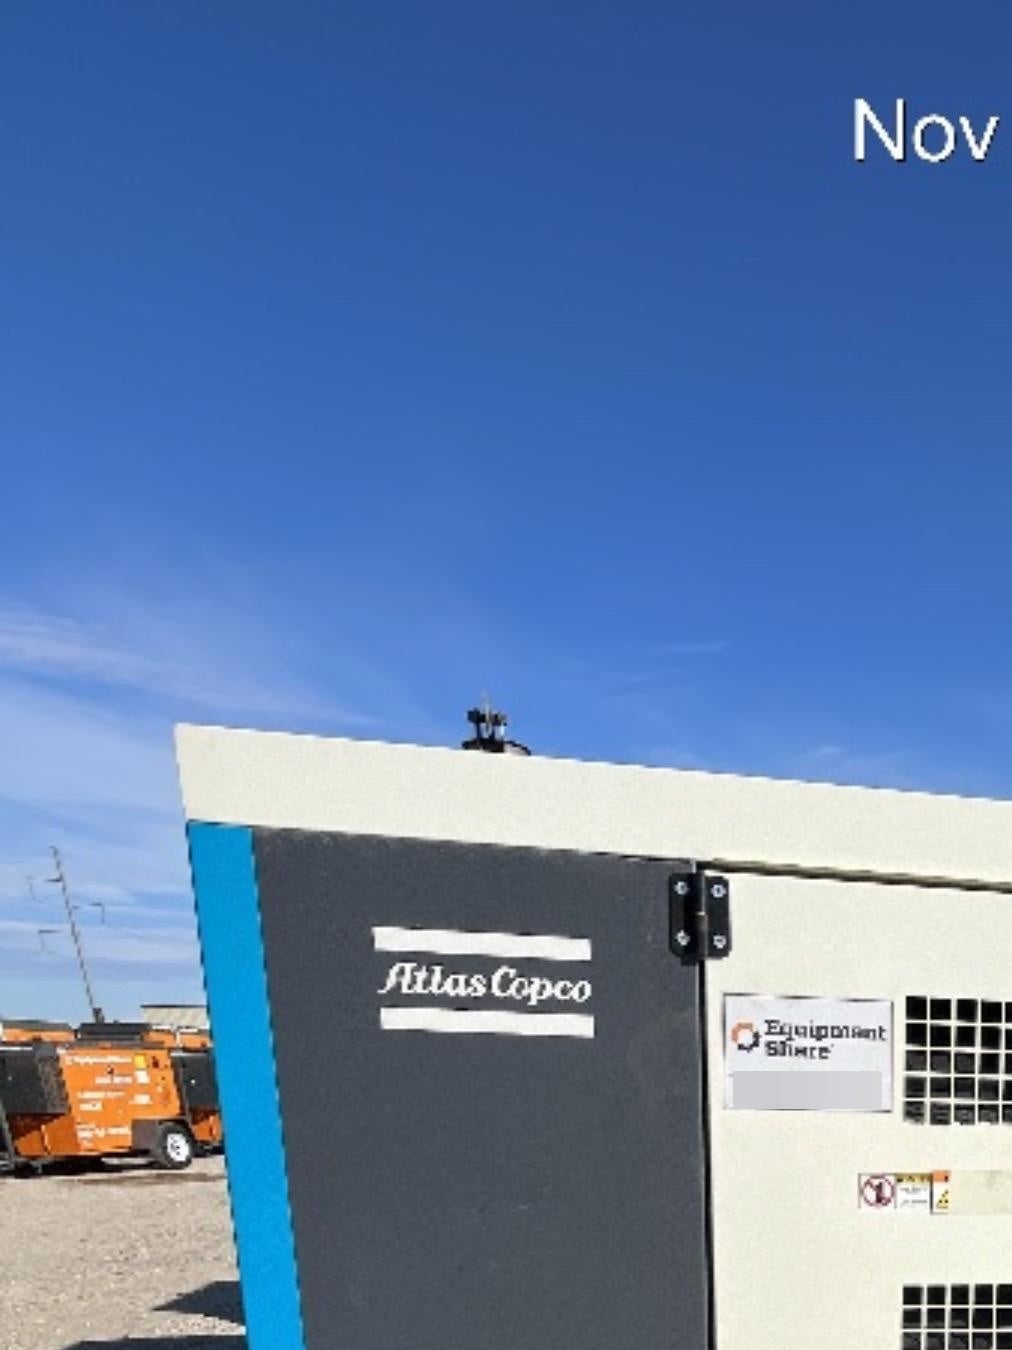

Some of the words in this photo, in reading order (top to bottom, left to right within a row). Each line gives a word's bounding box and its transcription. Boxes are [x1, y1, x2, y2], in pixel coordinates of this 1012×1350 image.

[377, 961, 488, 997] Atlas
[489, 964, 593, 1006] Copco
[764, 1018, 887, 1042] Equipment
